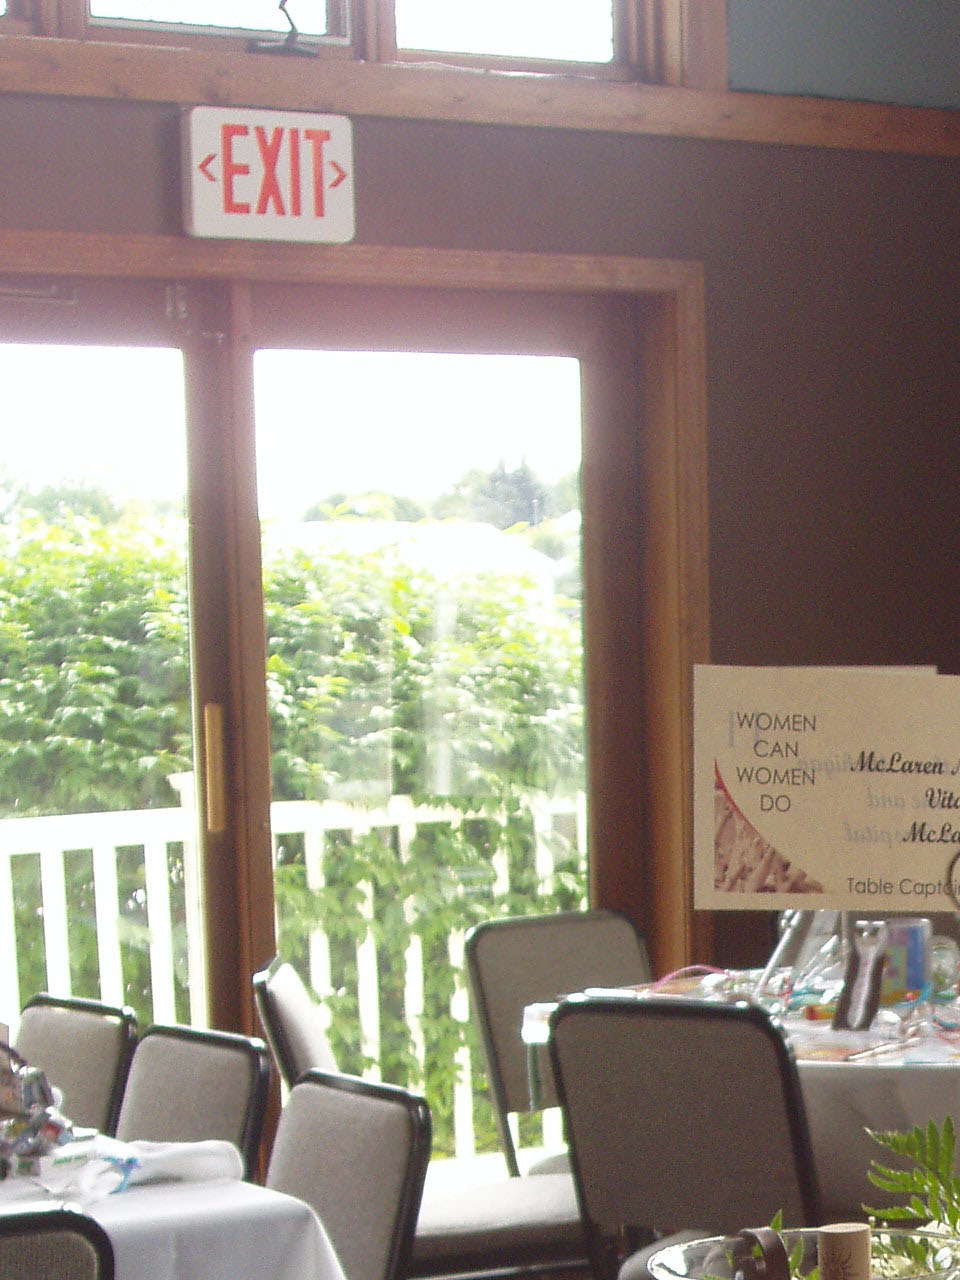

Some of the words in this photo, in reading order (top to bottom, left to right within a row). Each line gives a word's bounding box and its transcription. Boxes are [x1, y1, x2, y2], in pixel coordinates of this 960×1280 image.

[221, 124, 331, 218] EXIT
[736, 711, 817, 732] WOMEN
[753, 739, 799, 758] CAN
[850, 750, 945, 775] McLaren
[736, 766, 816, 786] WOMEN
[760, 794, 792, 813] DO
[847, 877, 894, 896] Table
